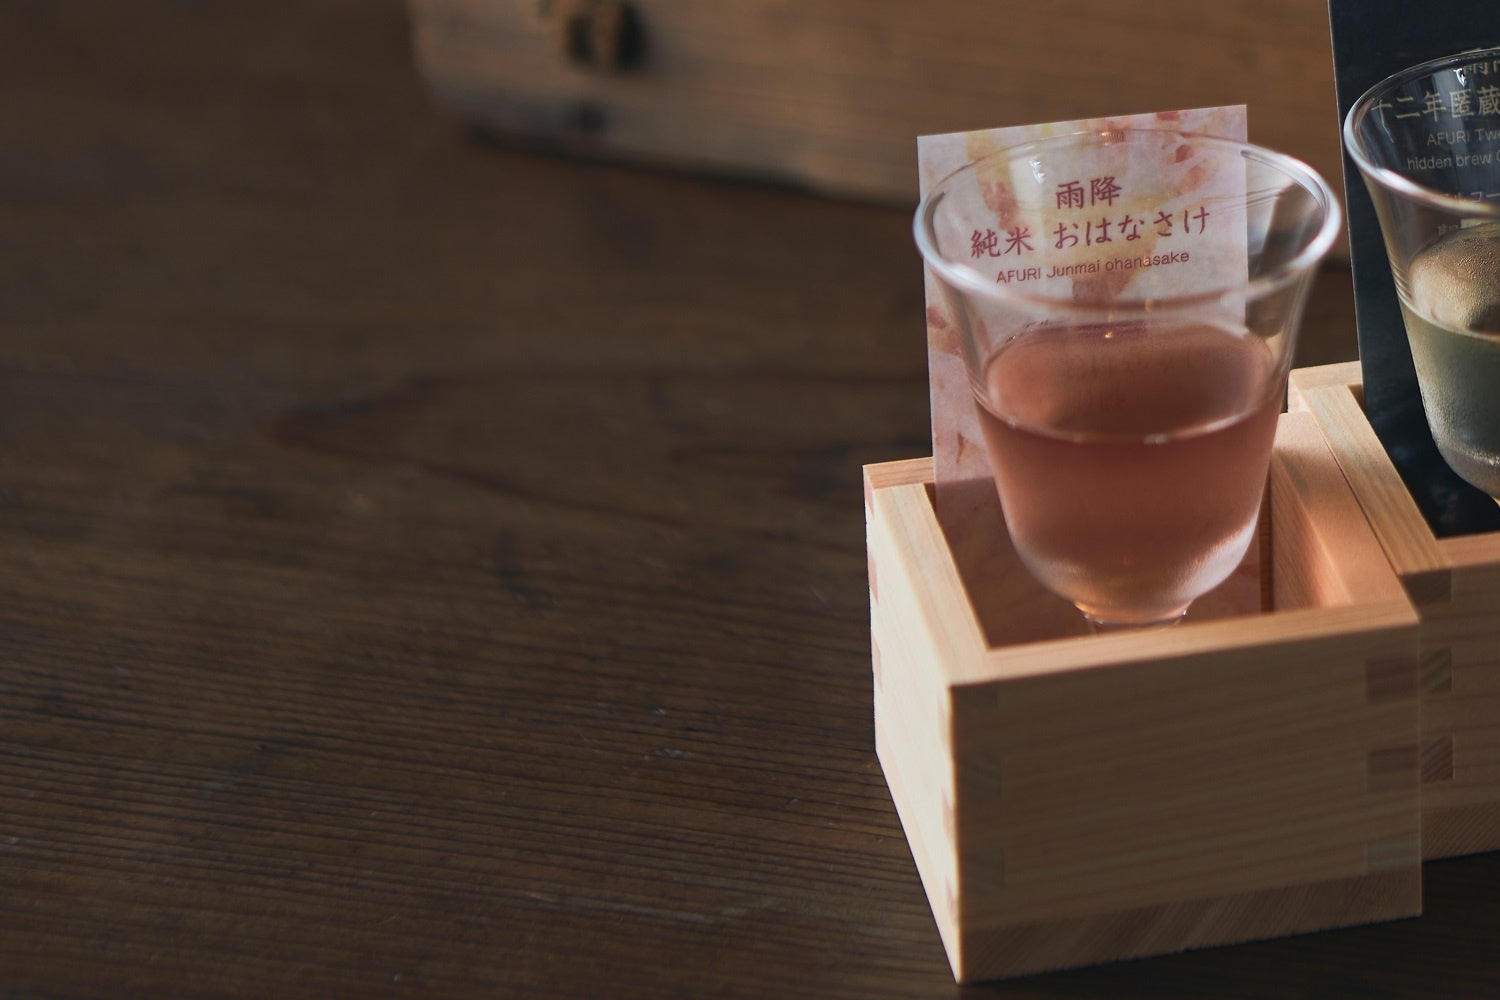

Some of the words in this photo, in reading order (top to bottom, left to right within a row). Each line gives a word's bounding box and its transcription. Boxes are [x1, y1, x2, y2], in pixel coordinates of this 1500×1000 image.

[1426, 129, 1470, 147] AFURI
[1406, 156, 1452, 171] hidden
[1455, 153, 1492, 168] brew
[1056, 175, 1123, 210] 雨降
[970, 226, 1035, 259] 純米
[1053, 206, 1210, 250] おはなさけ
[996, 266, 1042, 285] AFURI
[1046, 260, 1101, 279] Junmai
[1105, 250, 1191, 273] ohanasake
